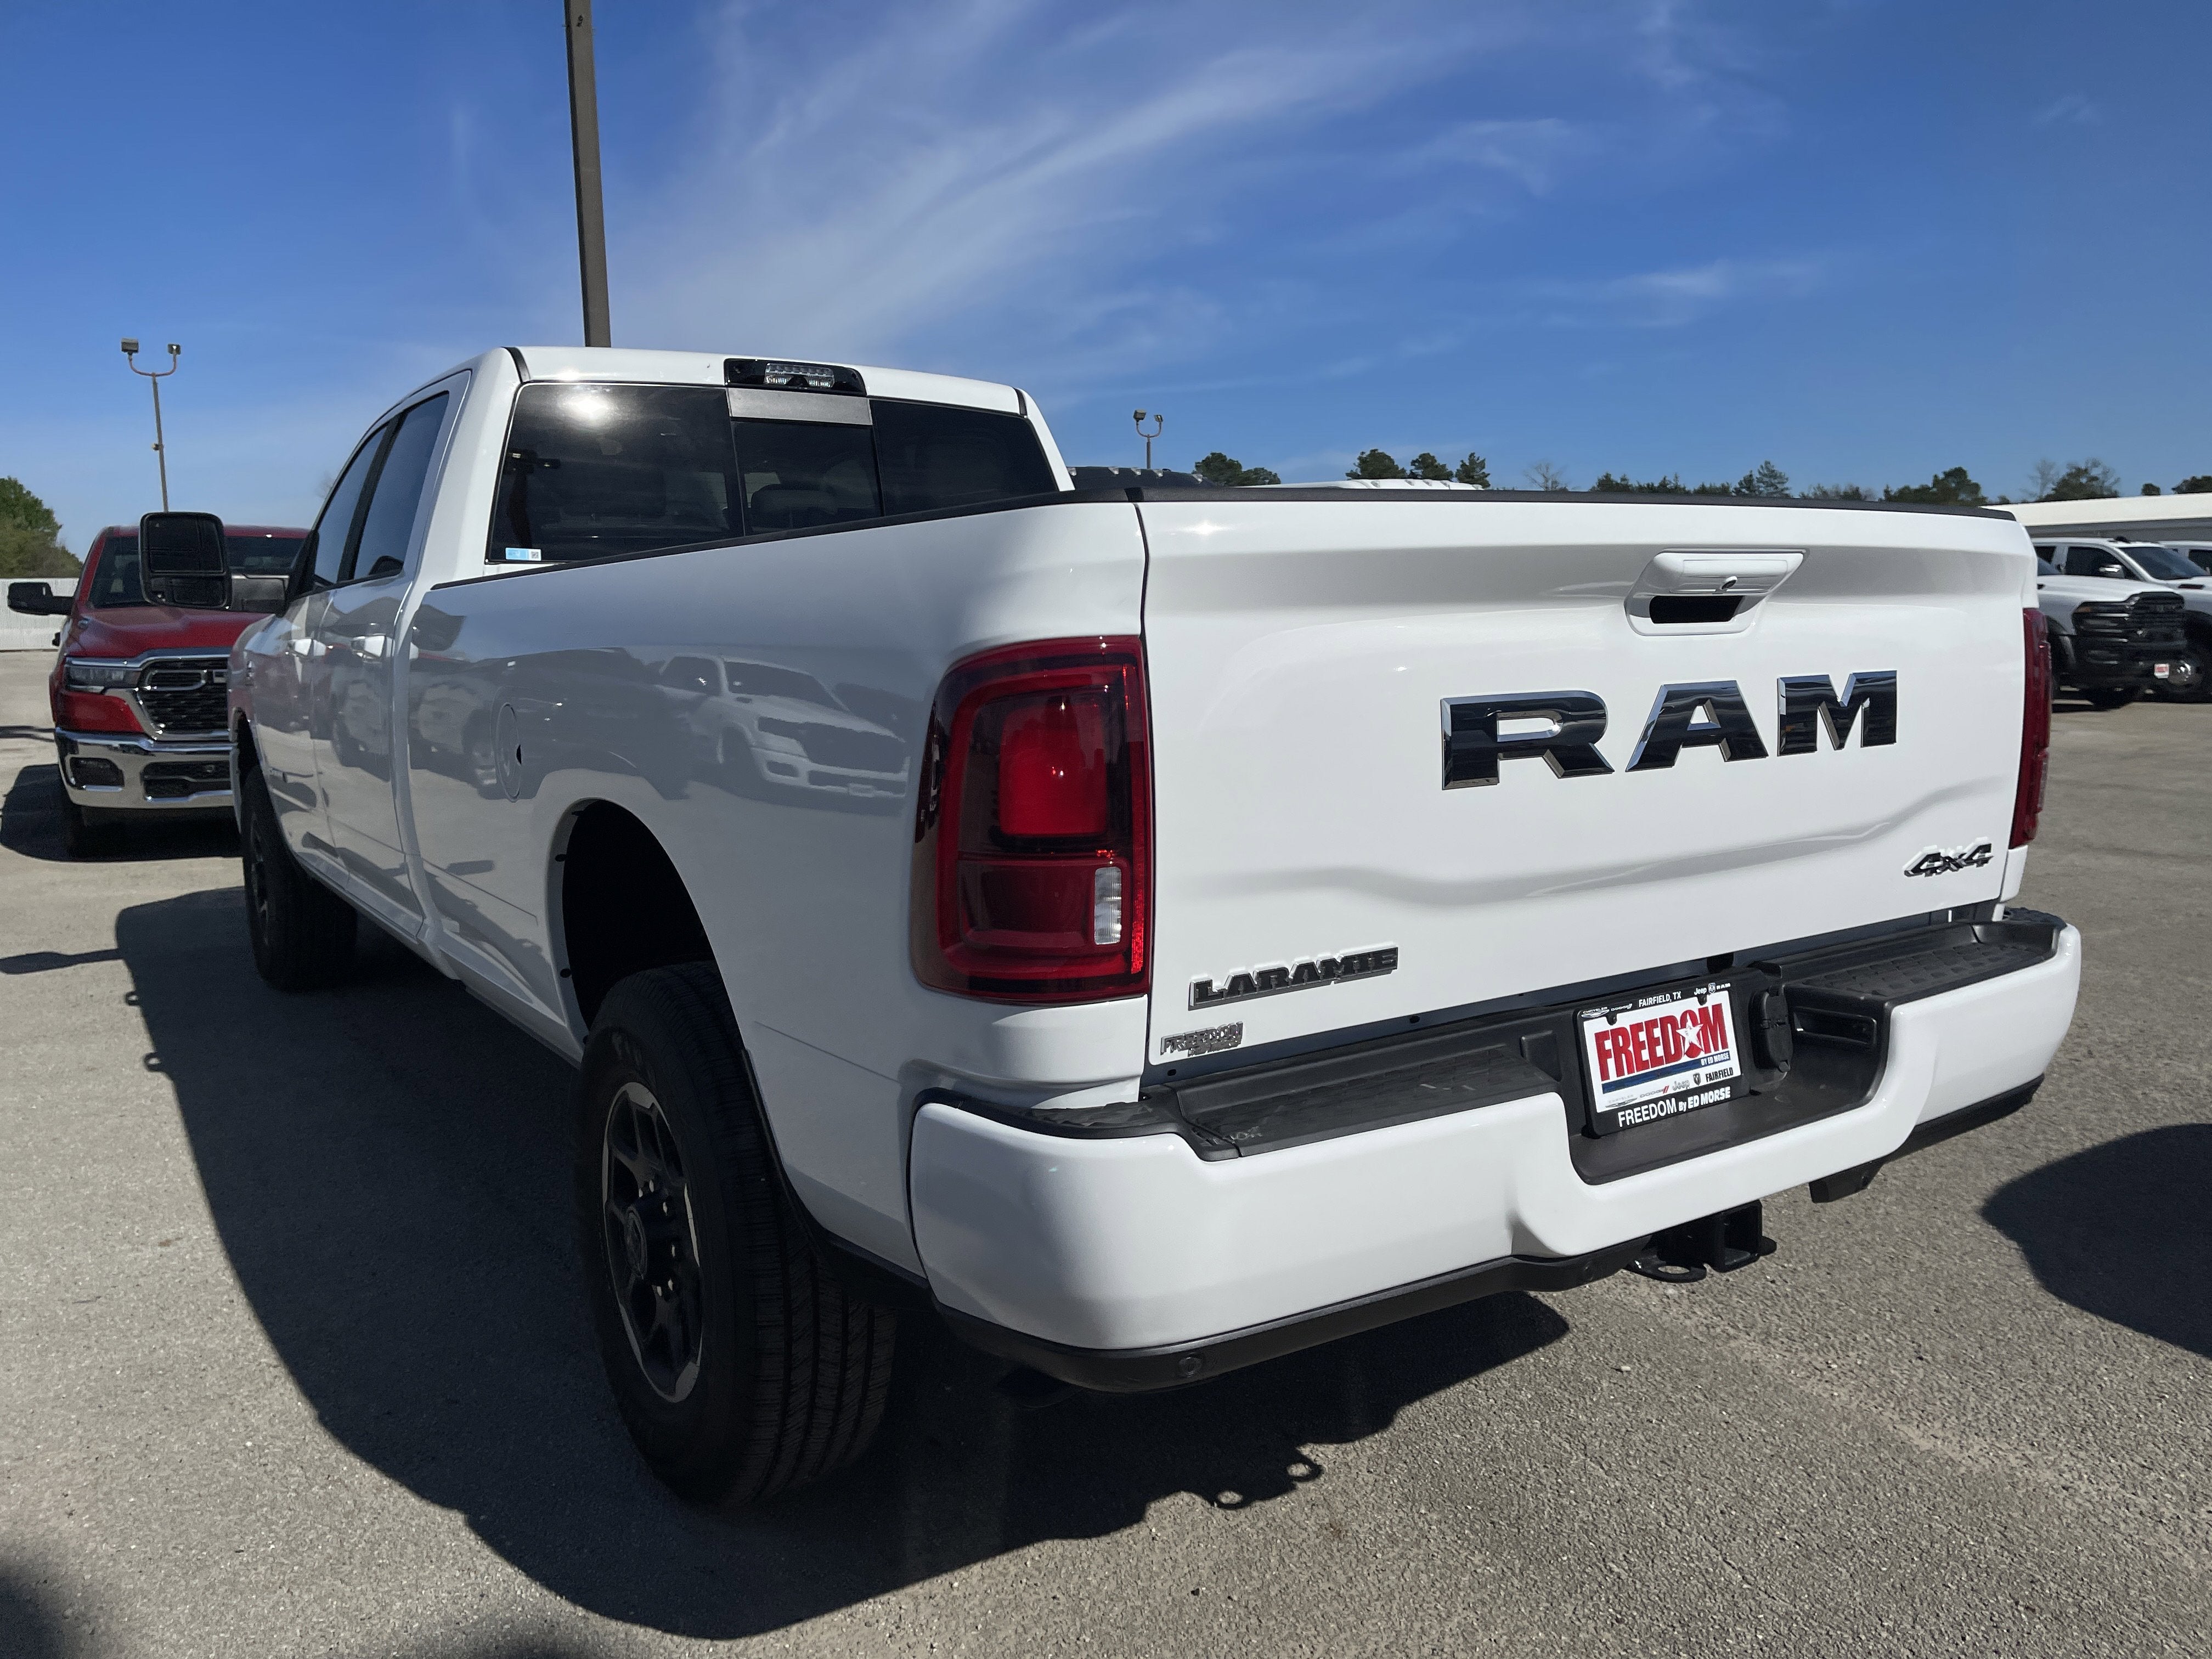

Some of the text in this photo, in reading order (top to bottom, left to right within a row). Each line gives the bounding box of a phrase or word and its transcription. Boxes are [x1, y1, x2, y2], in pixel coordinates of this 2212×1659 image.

[1441, 670, 1897, 790] RAM
[1188, 944, 1398, 1011] LARAMIE
[1639, 991, 1681, 1007] FAIRFIELD, TX
[1594, 1003, 1729, 1081] FREEDOM
[1713, 1052, 1729, 1063] MORSE
[1672, 1080, 1690, 1091] Jeep
[1705, 1067, 1733, 1082] FAIRFIELD
[1618, 1098, 1677, 1127] FREEDOM
[1688, 1094, 1699, 1109] ED
[1701, 1087, 1730, 1105] MORSE
